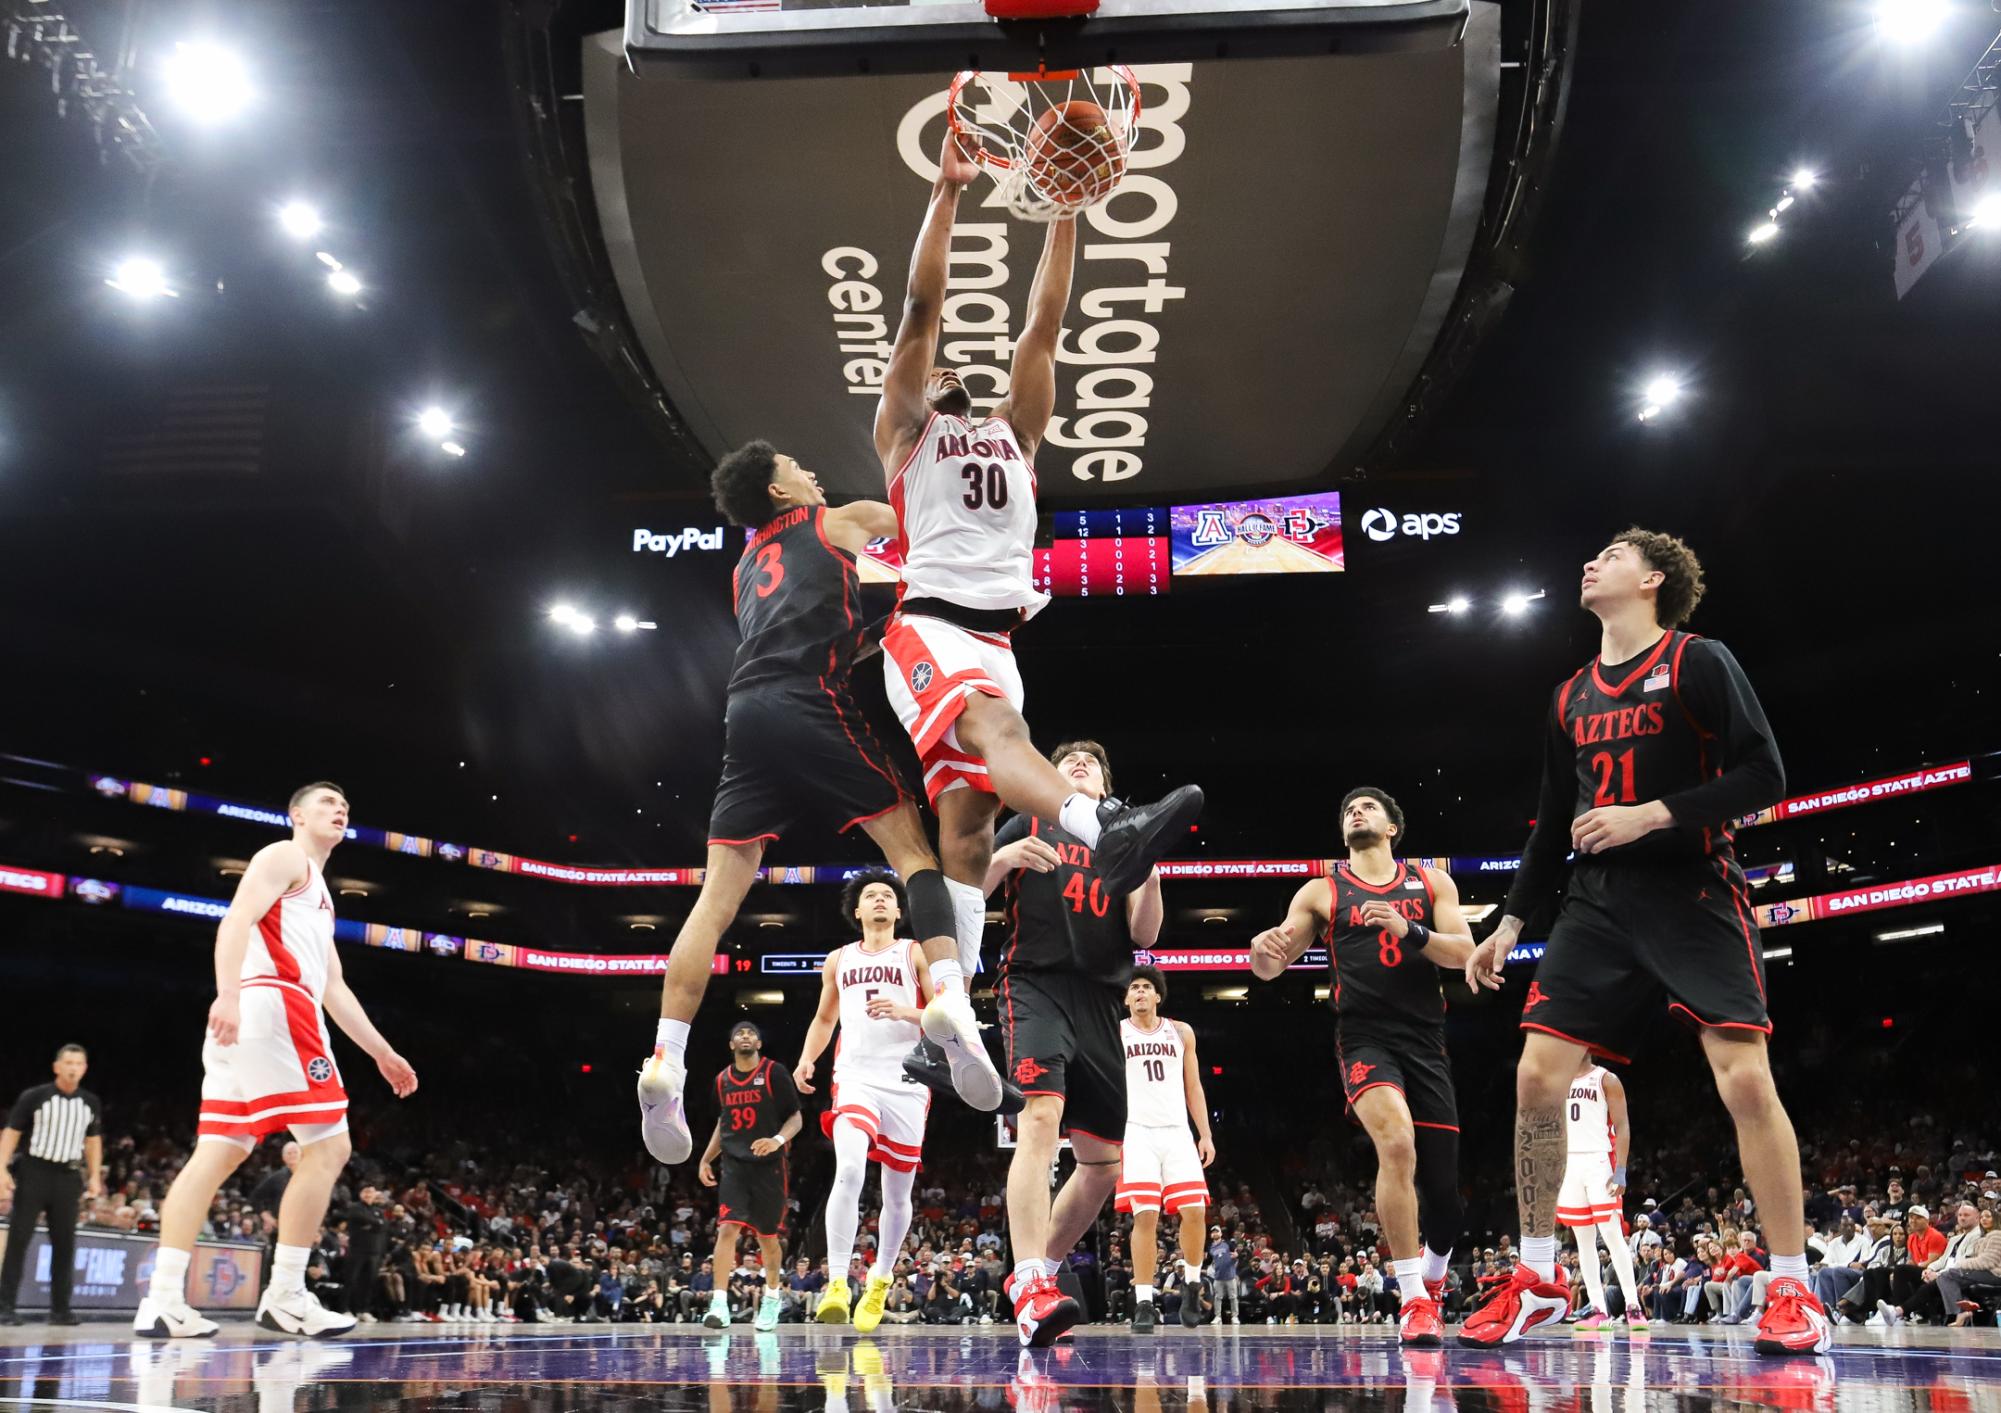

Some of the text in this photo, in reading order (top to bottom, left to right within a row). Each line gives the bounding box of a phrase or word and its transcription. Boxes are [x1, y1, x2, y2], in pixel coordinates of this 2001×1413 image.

[1043, 63, 1193, 483] mortgage
[936, 433, 1020, 464] ARIONA
[961, 462, 1008, 510] 30
[1079, 512, 1154, 525] 5 1 3
[1402, 512, 1461, 541] aps
[1078, 525, 1155, 537] 12 1 2
[633, 526, 724, 558] PayPal
[1080, 537, 1155, 549] 3 0 0
[1043, 550, 1156, 561] 4 4 0 2
[755, 542, 785, 598] 3
[1043, 562, 1156, 573] 4 2 0 1
[1044, 576, 1051, 585] 8
[1081, 576, 1088, 585] 3
[1116, 575, 1124, 584] 2
[1150, 574, 1157, 583] 3
[1081, 587, 1089, 597] 5
[1116, 586, 1124, 596] 0
[1150, 586, 1158, 595] 3
[1574, 702, 1664, 747] AZTECS
[1592, 747, 1638, 808] 21
[1788, 766, 1970, 813] SAN DIEGO STATE AZTE
[217, 804, 286, 826] ARIZONA
[521, 862, 678, 881] SAN DIEGO STATE AZTECS
[1172, 865, 1213, 875] DIEGO
[1214, 865, 1256, 874] STATE
[1256, 864, 1309, 873] AZTECS
[1480, 860, 1521, 871] ARIZO
[1062, 872, 1111, 918] 40
[1828, 893, 1868, 911] SAN
[1869, 884, 1930, 903] DIEGO
[1931, 872, 1994, 893] STATE
[161, 897, 228, 918] ARIZON
[1378, 928, 1402, 967] 8
[526, 953, 558, 967] SAN
[558, 957, 607, 971] DIEGO
[607, 959, 654, 970] STATE
[735, 960, 752, 972] 19
[1161, 955, 1188, 964] SAN
[1190, 955, 1232, 964] DIEGO
[842, 965, 904, 990] ARIZONA
[1126, 1043, 1177, 1059] ARIZONA
[1143, 1059, 1165, 1082] 10
[725, 1089, 762, 1106] AZTECS
[730, 1107, 757, 1131] 39
